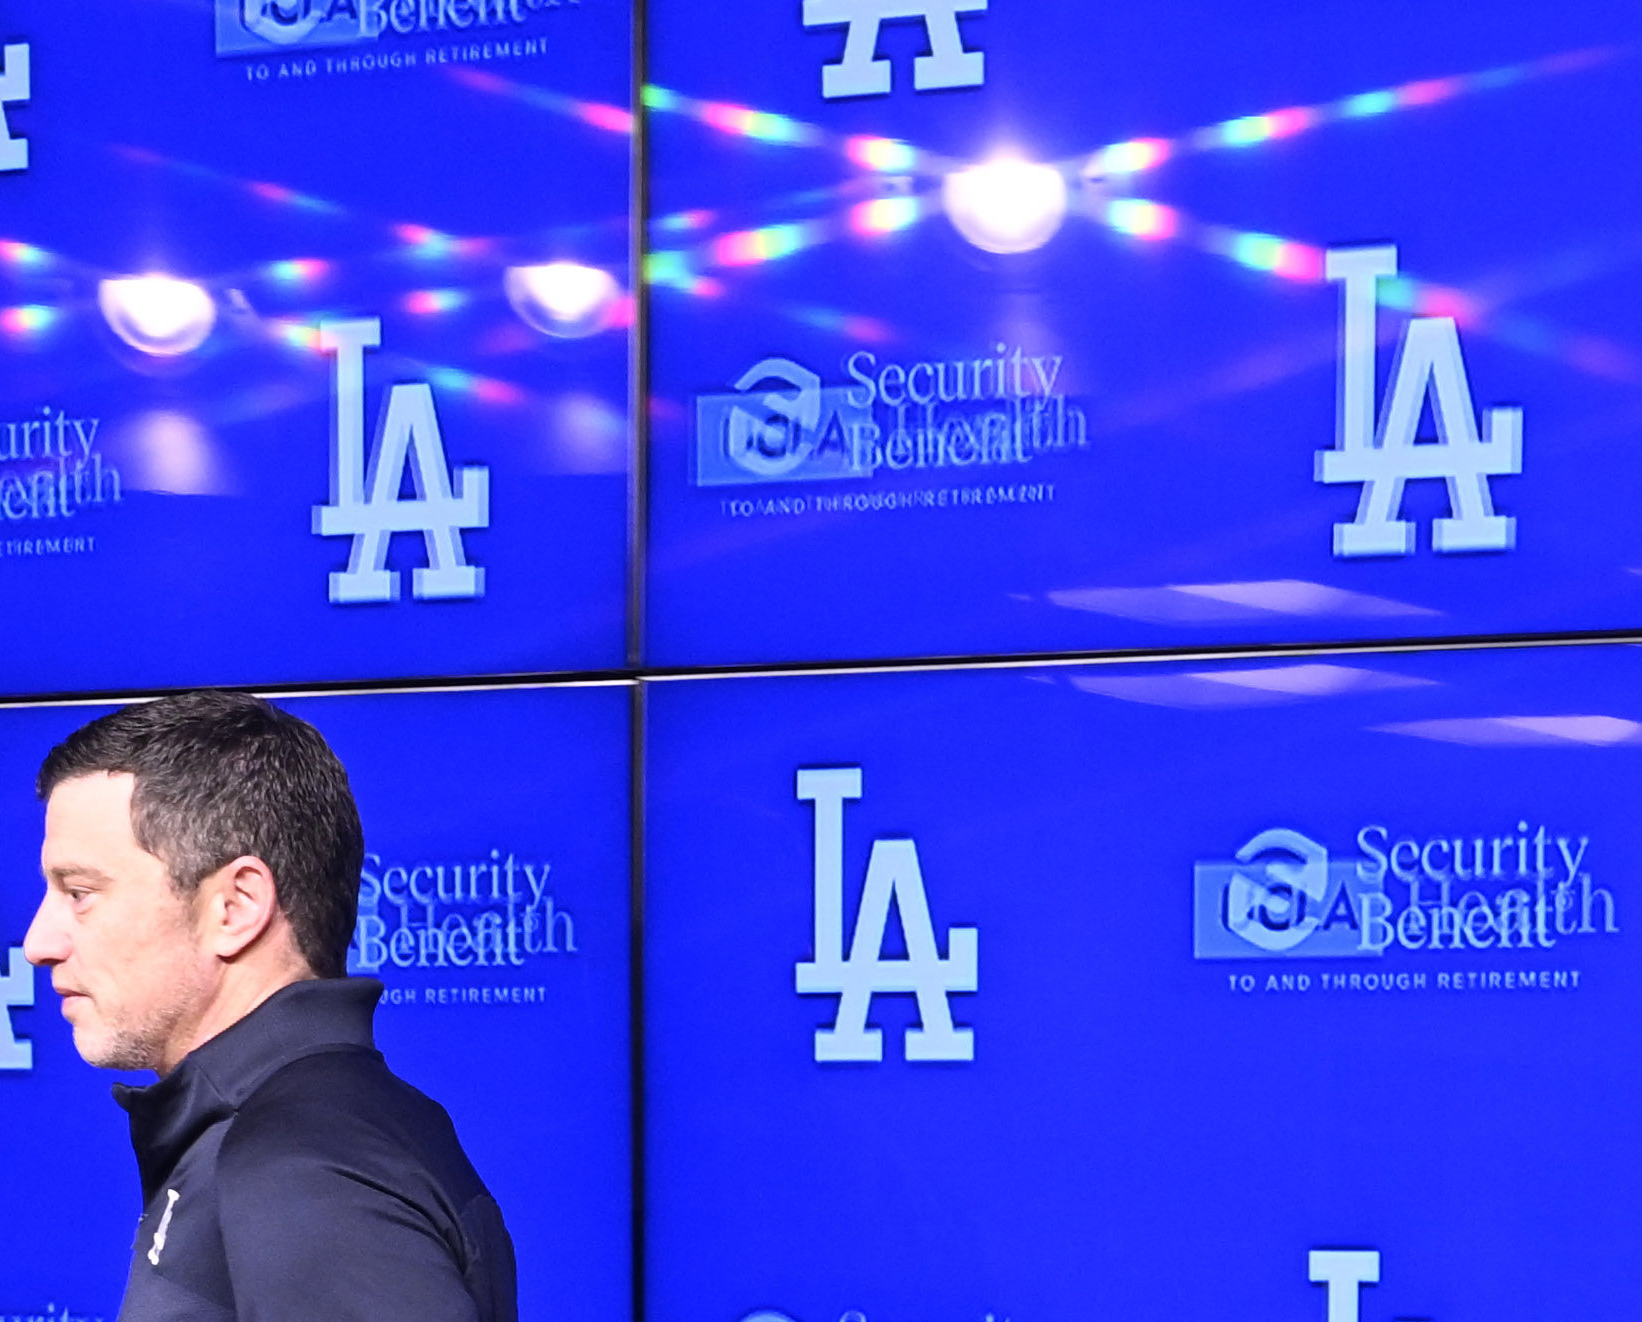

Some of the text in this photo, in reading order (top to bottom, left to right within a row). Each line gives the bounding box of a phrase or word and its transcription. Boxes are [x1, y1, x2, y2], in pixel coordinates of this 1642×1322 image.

[247, 39, 548, 83] TO AND THROUGH RETIREMENT
[847, 343, 1062, 403] Security
[1313, 245, 1522, 556] LA
[311, 317, 489, 602] LA
[848, 408, 1034, 473] Benefit
[359, 849, 550, 909] Security
[1357, 821, 1588, 886] Security
[356, 911, 525, 967] Benefit
[795, 767, 978, 1062] LA
[1358, 888, 1557, 949] Benefit
[424, 986, 546, 1004] RETIREMENT
[1230, 970, 1580, 991] TO AND THROUGH RETIREMENT
